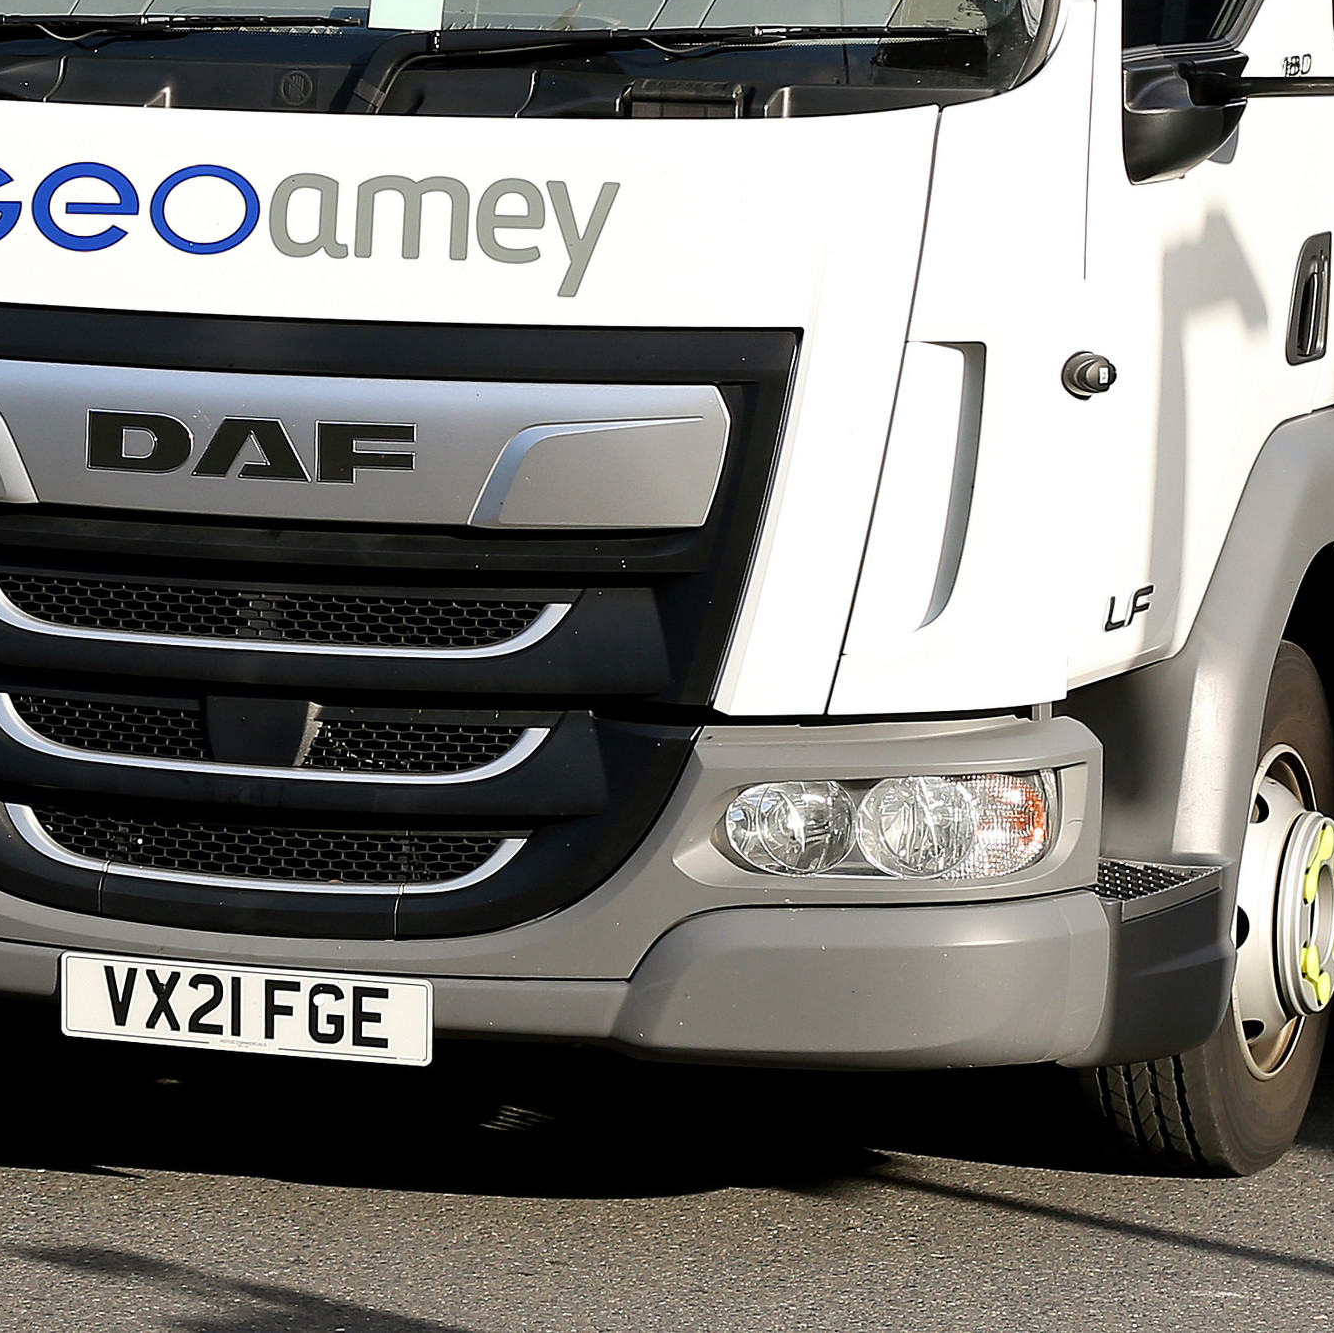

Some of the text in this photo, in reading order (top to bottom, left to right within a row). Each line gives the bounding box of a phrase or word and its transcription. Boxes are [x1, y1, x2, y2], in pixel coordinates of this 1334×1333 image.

[86, 408, 417, 484] DAF
[1104, 584, 1154, 633] LF
[103, 965, 389, 1049] VX21 FGE
